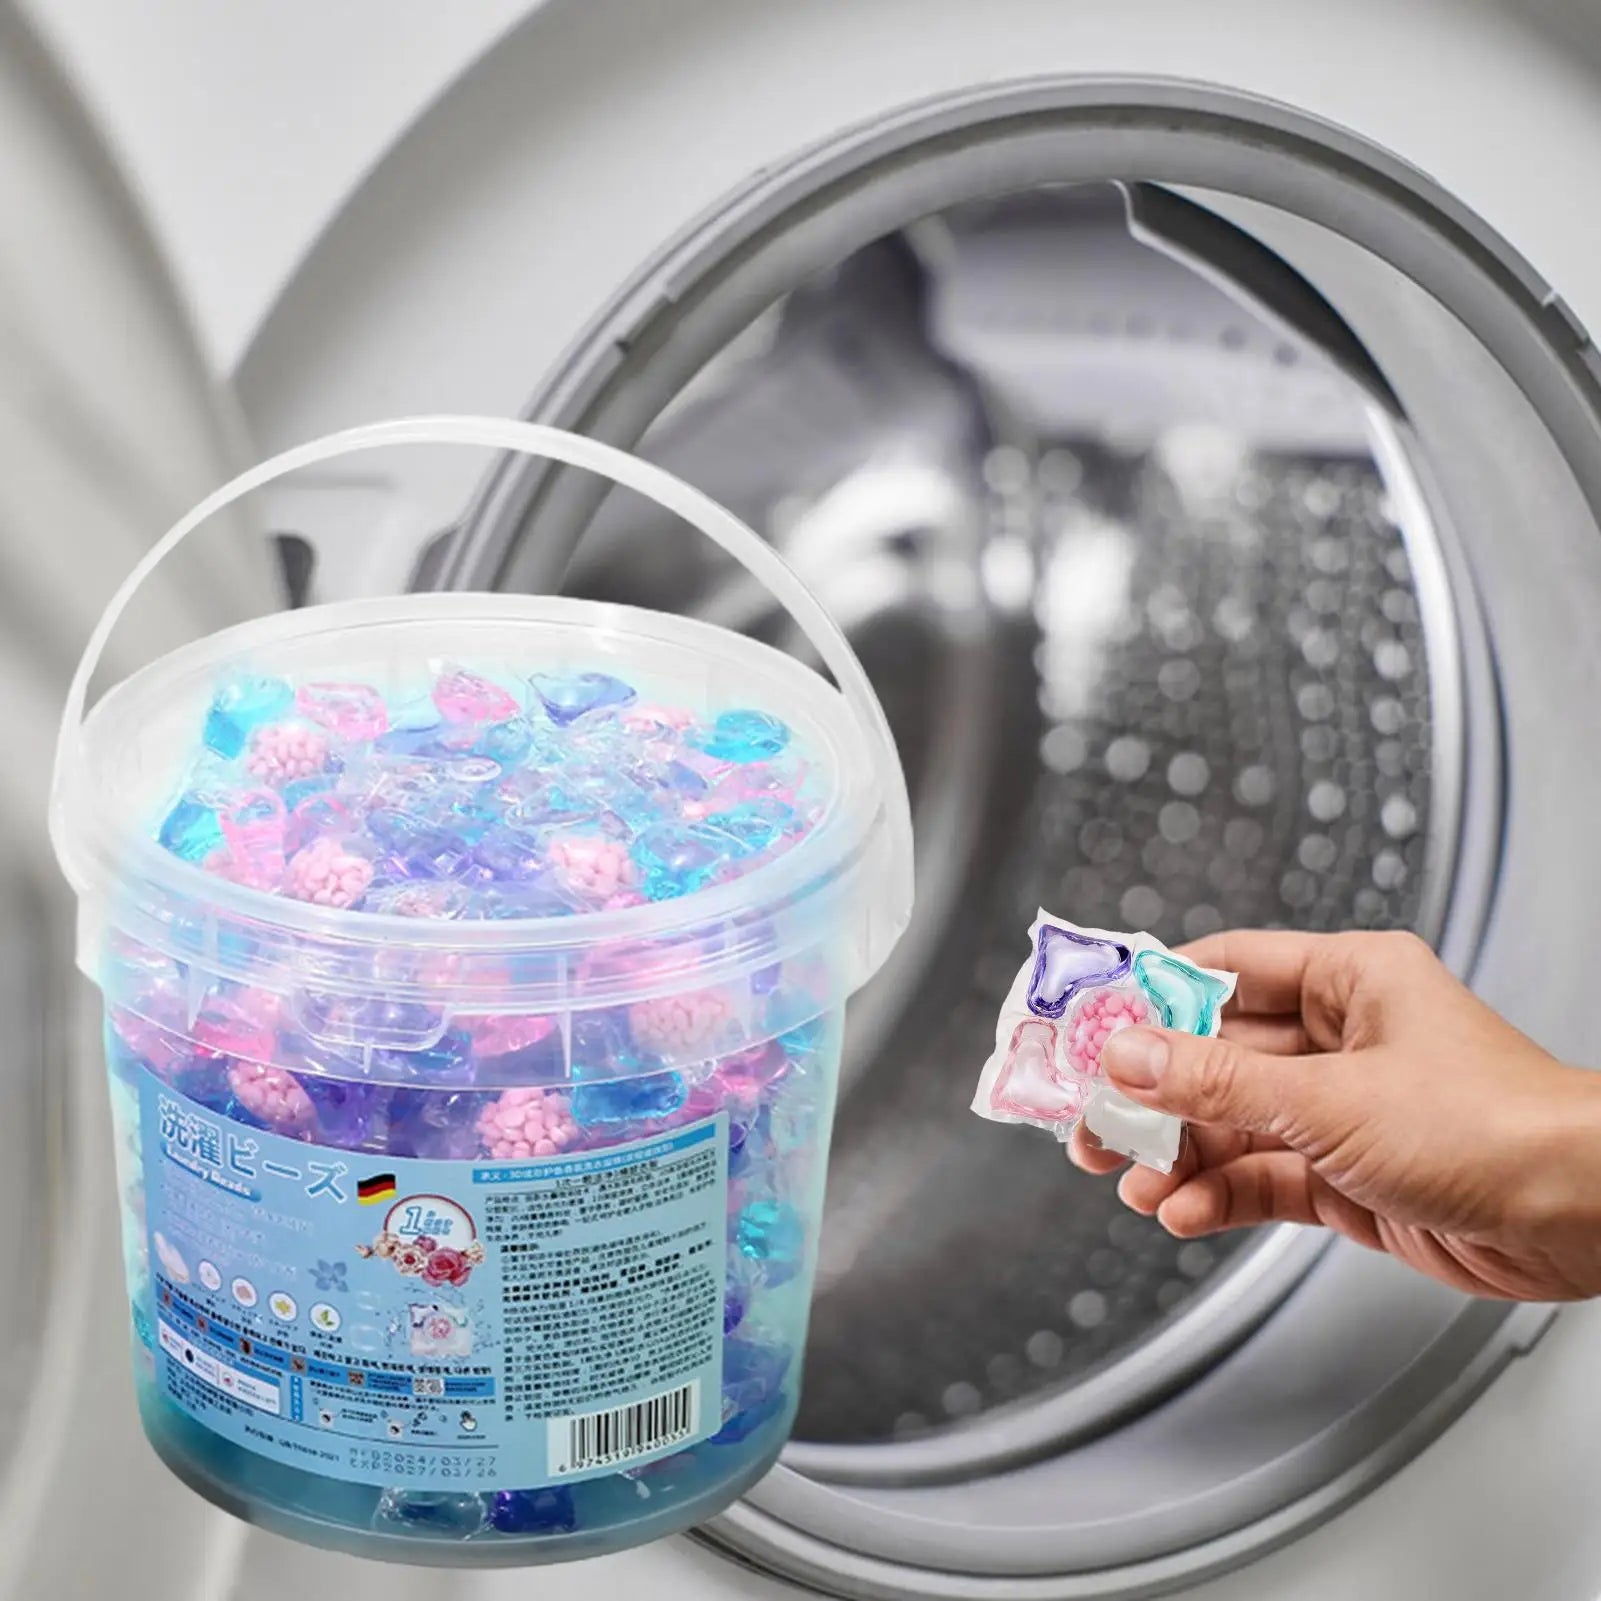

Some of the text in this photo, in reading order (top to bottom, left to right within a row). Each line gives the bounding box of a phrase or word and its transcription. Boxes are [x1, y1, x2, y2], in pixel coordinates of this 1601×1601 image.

[158, 1094, 348, 1204] 洗濯ビーズ
